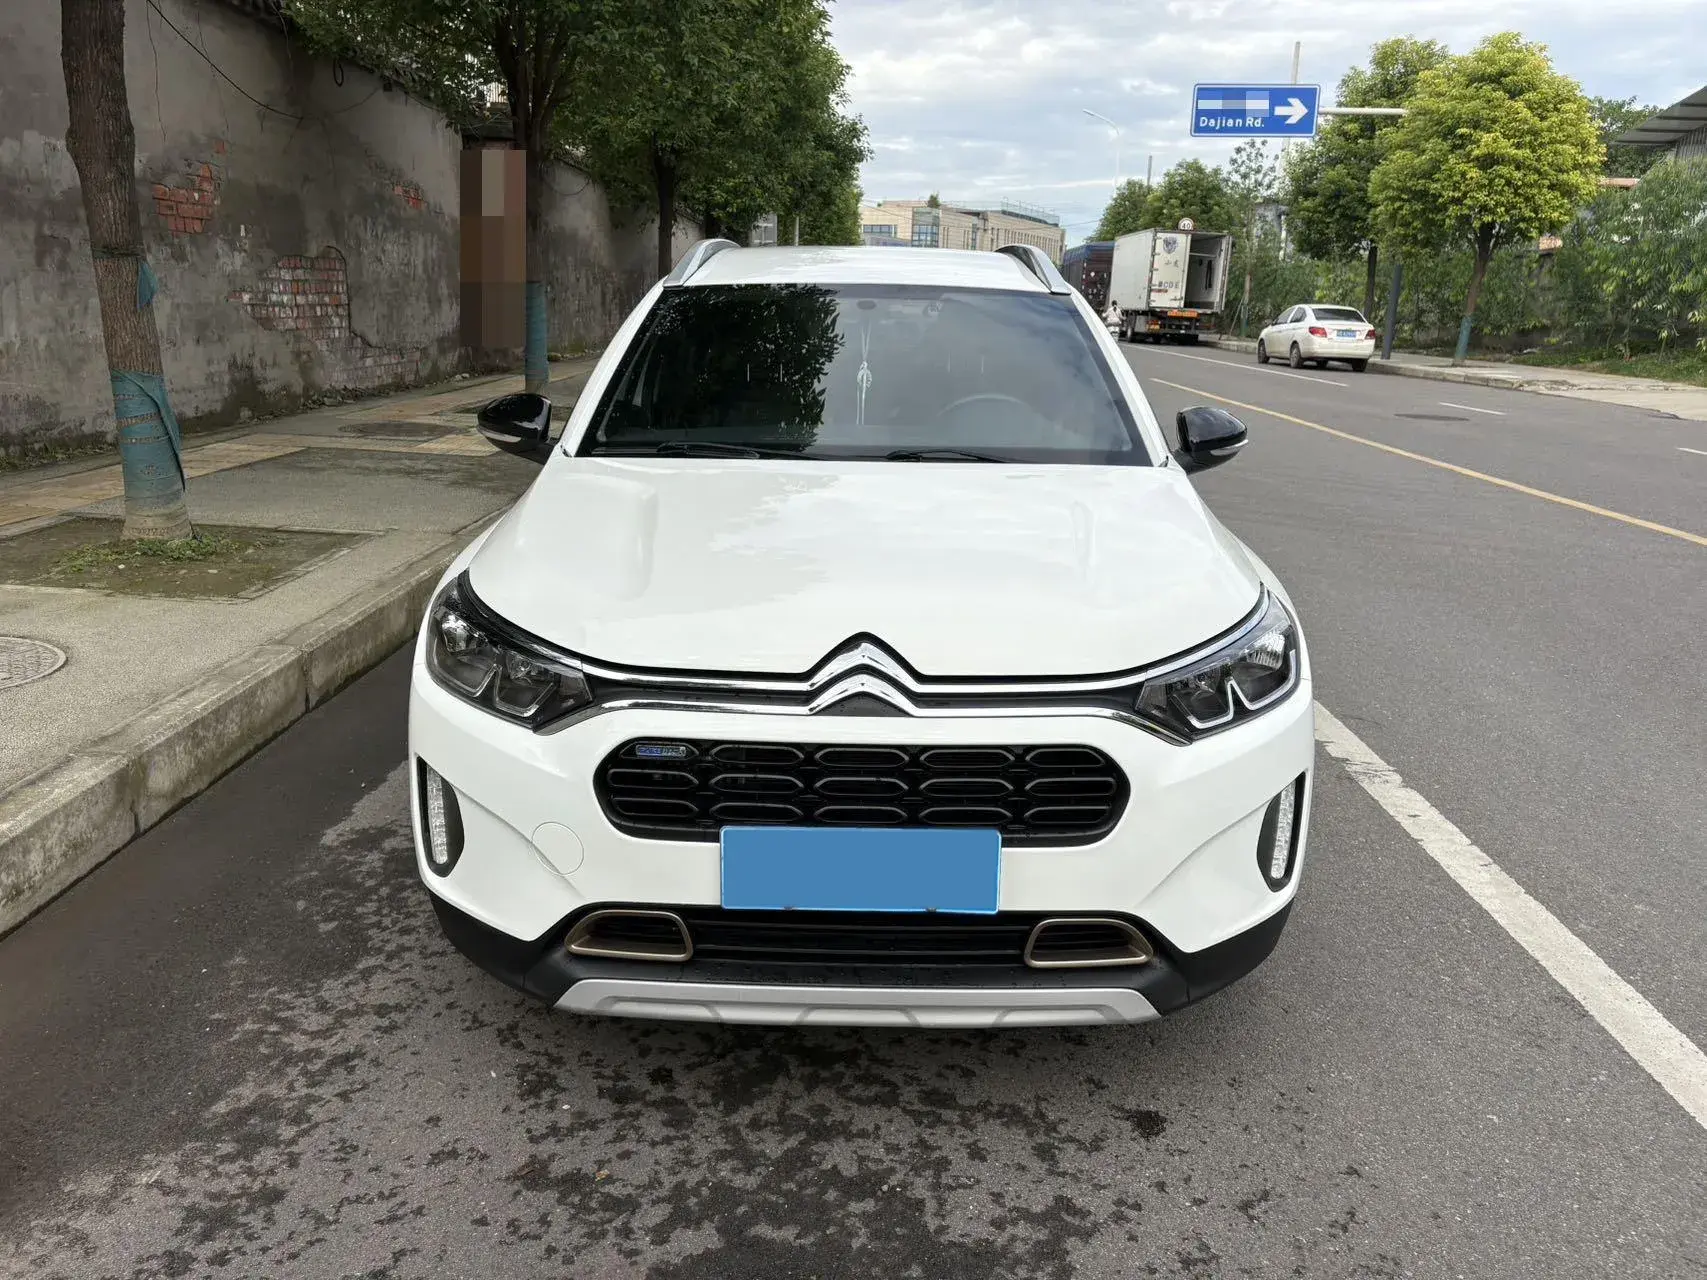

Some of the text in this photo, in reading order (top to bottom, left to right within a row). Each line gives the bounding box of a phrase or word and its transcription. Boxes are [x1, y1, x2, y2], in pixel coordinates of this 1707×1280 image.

[1199, 116, 1265, 130] Dajian Rd.
[1181, 222, 1191, 230] 40
